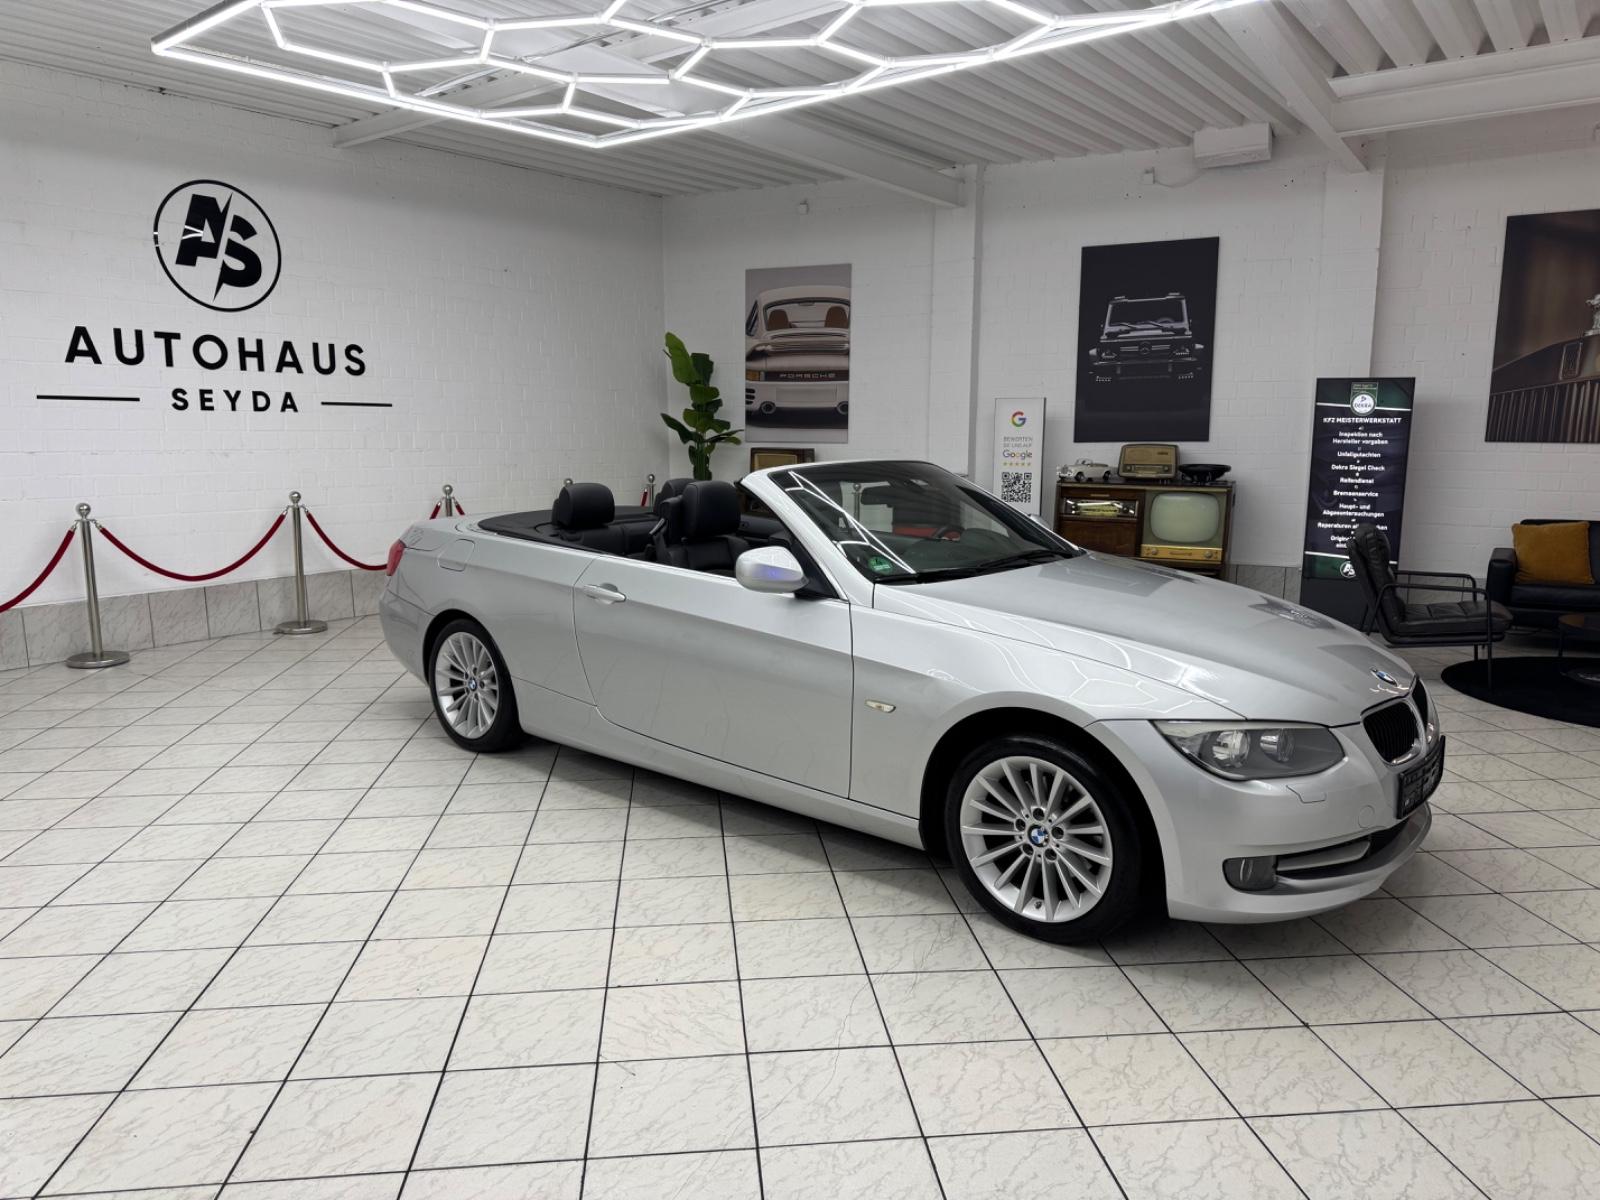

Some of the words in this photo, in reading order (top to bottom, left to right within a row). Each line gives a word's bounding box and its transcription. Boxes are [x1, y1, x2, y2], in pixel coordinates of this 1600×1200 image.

[64, 325, 367, 377] AUTOHAUS
[171, 387, 299, 413] SEYDA
[1002, 448, 1033, 460] Google
[1322, 509, 1384, 518] Abgasuntersuchungen
